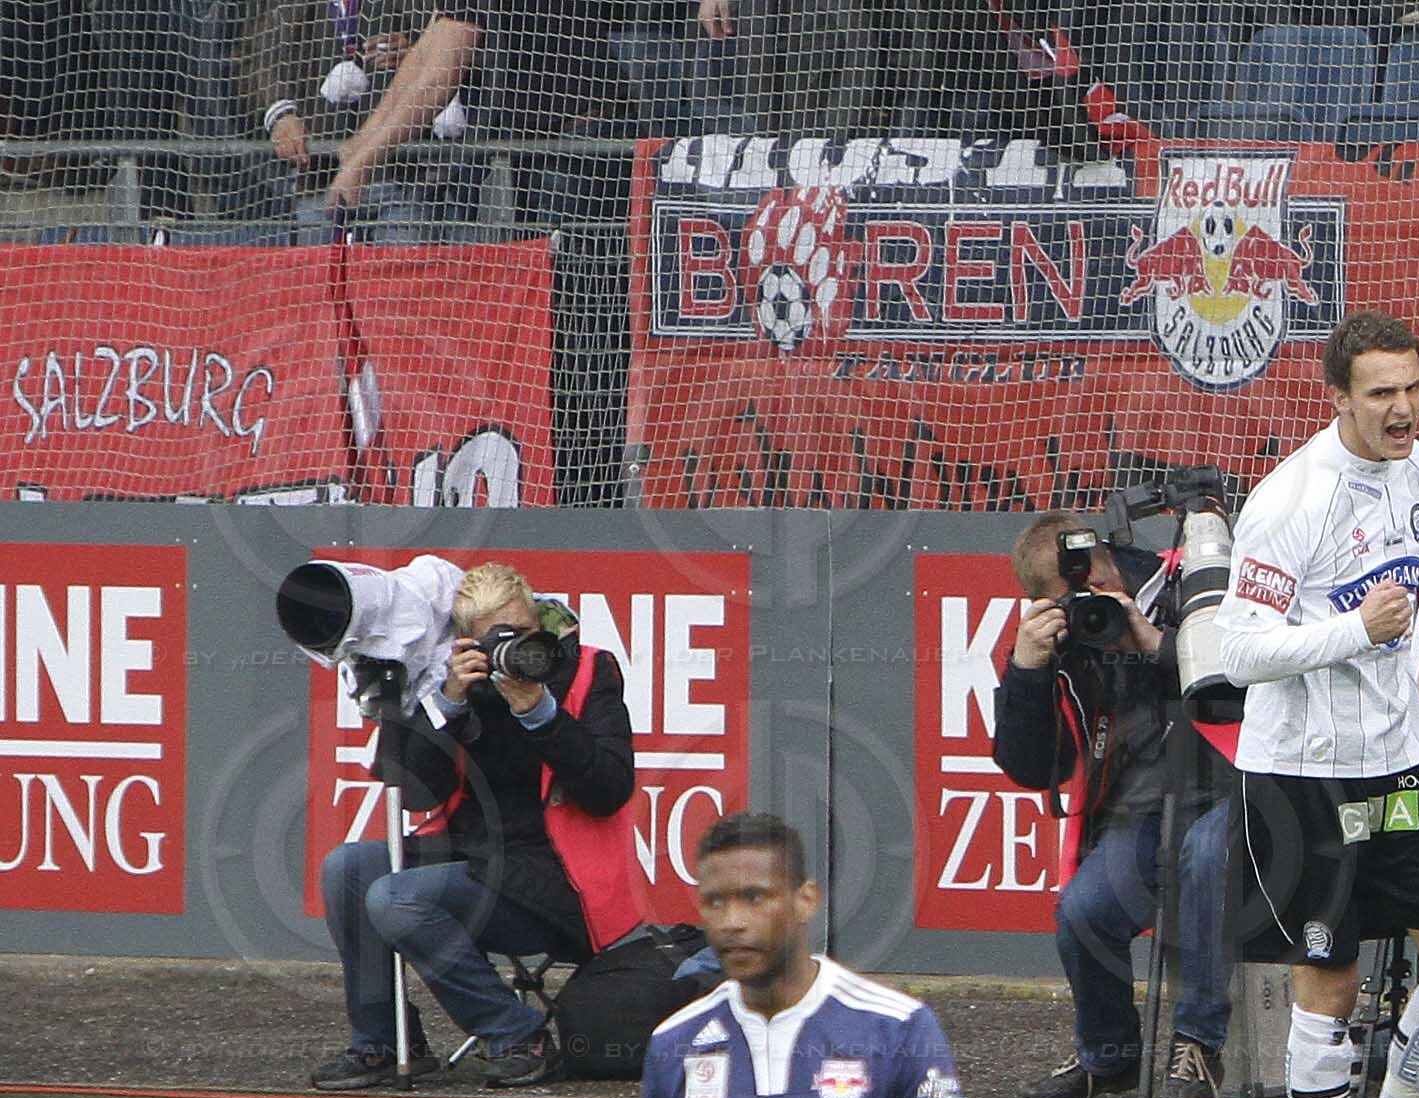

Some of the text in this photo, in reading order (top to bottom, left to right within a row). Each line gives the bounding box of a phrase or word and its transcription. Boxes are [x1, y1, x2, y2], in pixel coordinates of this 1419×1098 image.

[1162, 163, 1223, 209] Red
[1226, 163, 1284, 209] Bull
[12, 346, 274, 454] SALZBURG
